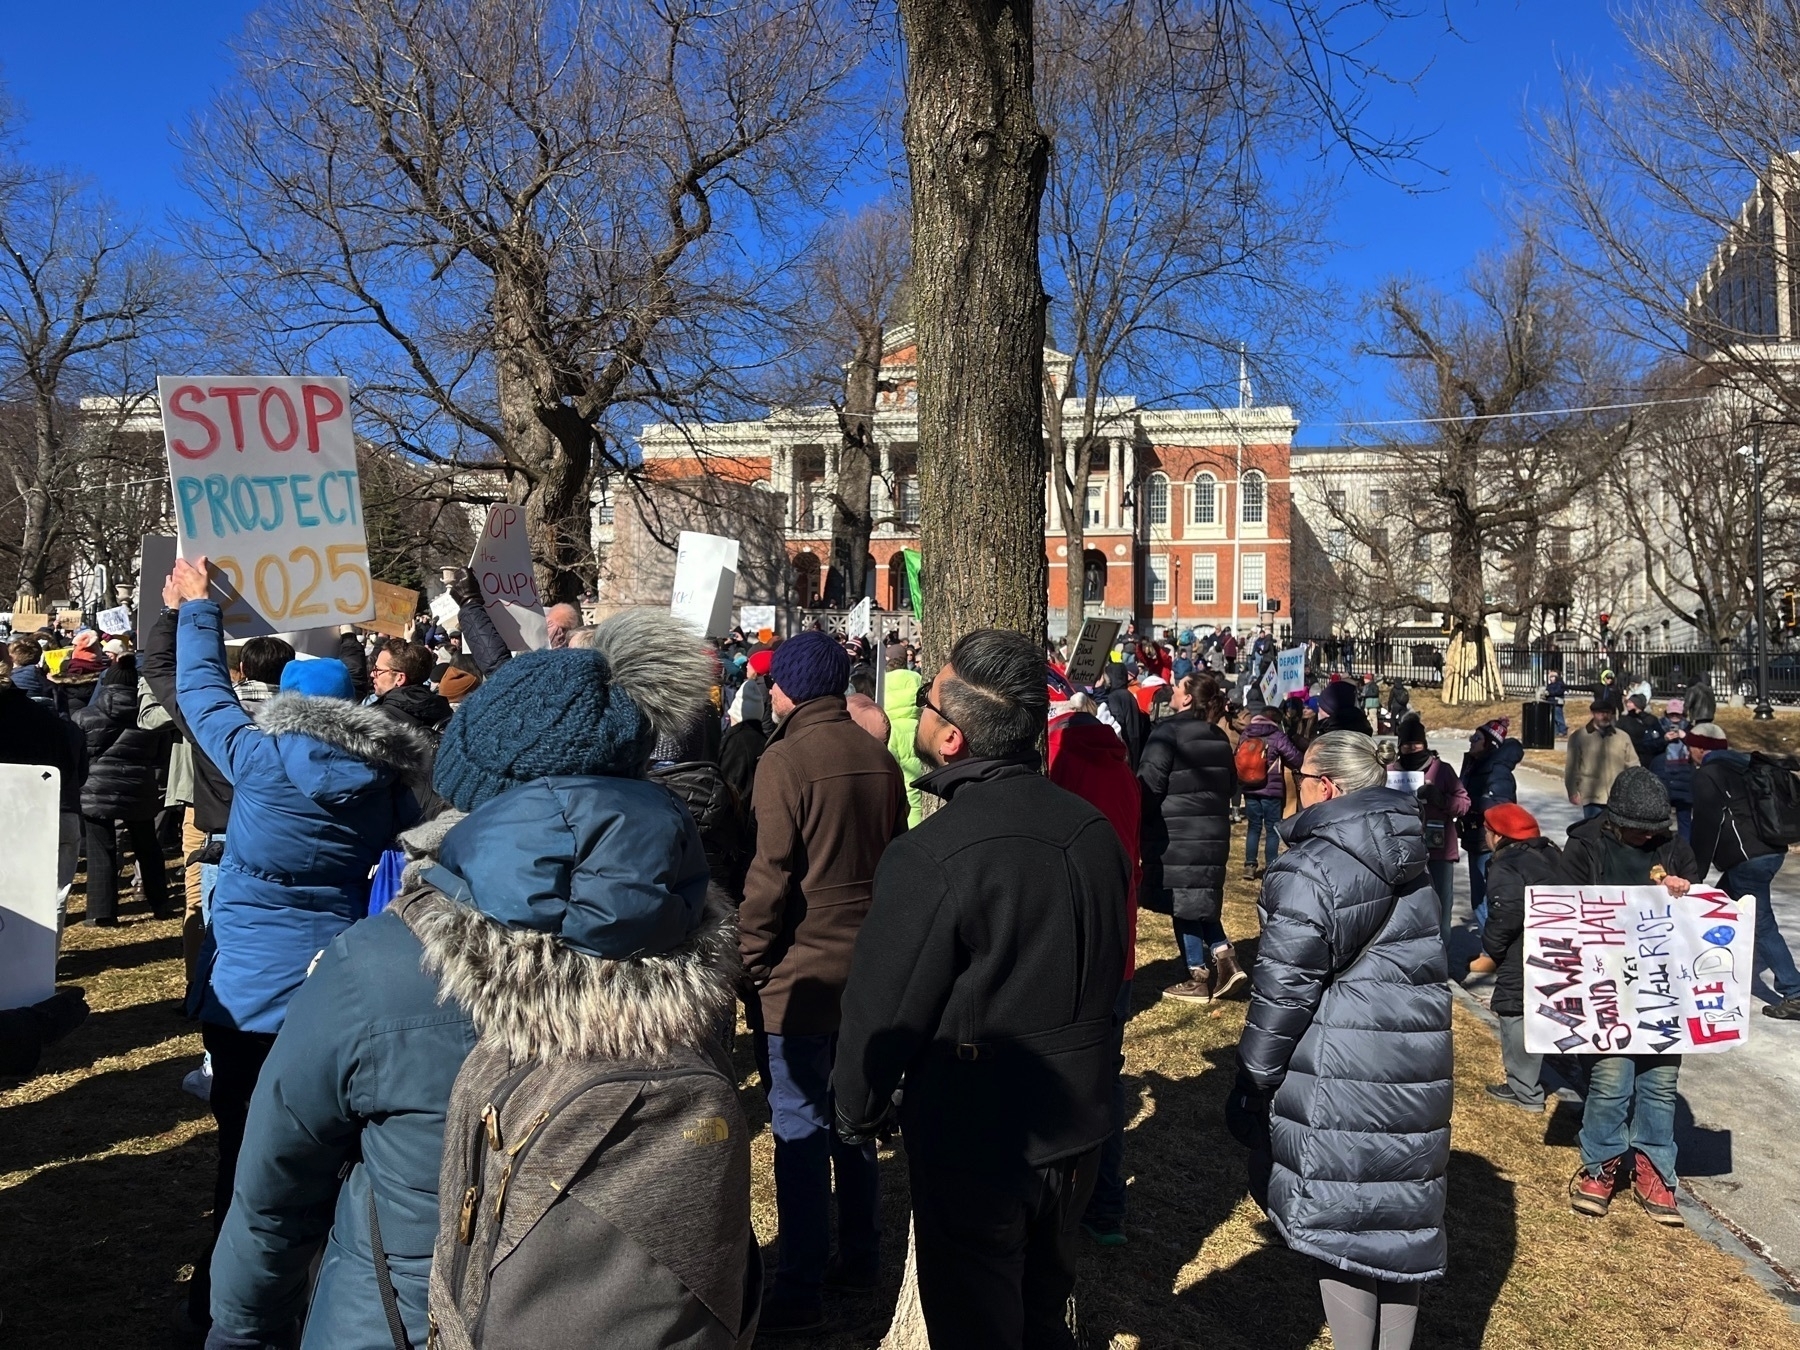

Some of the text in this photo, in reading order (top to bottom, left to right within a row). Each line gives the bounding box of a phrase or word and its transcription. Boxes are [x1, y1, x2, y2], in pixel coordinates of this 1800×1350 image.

[169, 384, 344, 460] STOP
[176, 470, 358, 539] PROJECT
[484, 507, 517, 540] TOP
[480, 547, 498, 563] the
[208, 544, 371, 626] 2025
[474, 570, 538, 601] OUP!
[850, 601, 865, 626] STOP
[1076, 643, 1093, 656] Black
[1077, 657, 1095, 667] Lives
[1280, 655, 1303, 667] DEPORT
[1283, 670, 1298, 680] ELON
[1526, 888, 1578, 931] NOT
[1578, 890, 1632, 1053] STAND for HATE
[1623, 956, 1640, 987] YET
[1636, 904, 1682, 1054] WE WILL RISE
[1676, 964, 1692, 982] for
[1686, 891, 1744, 1046] FREEDOM
[1535, 997, 1589, 1054] WE
[683, 1127, 715, 1140] NORTH
[696, 1118, 715, 1128] THE
[694, 1135, 716, 1146] FACE
